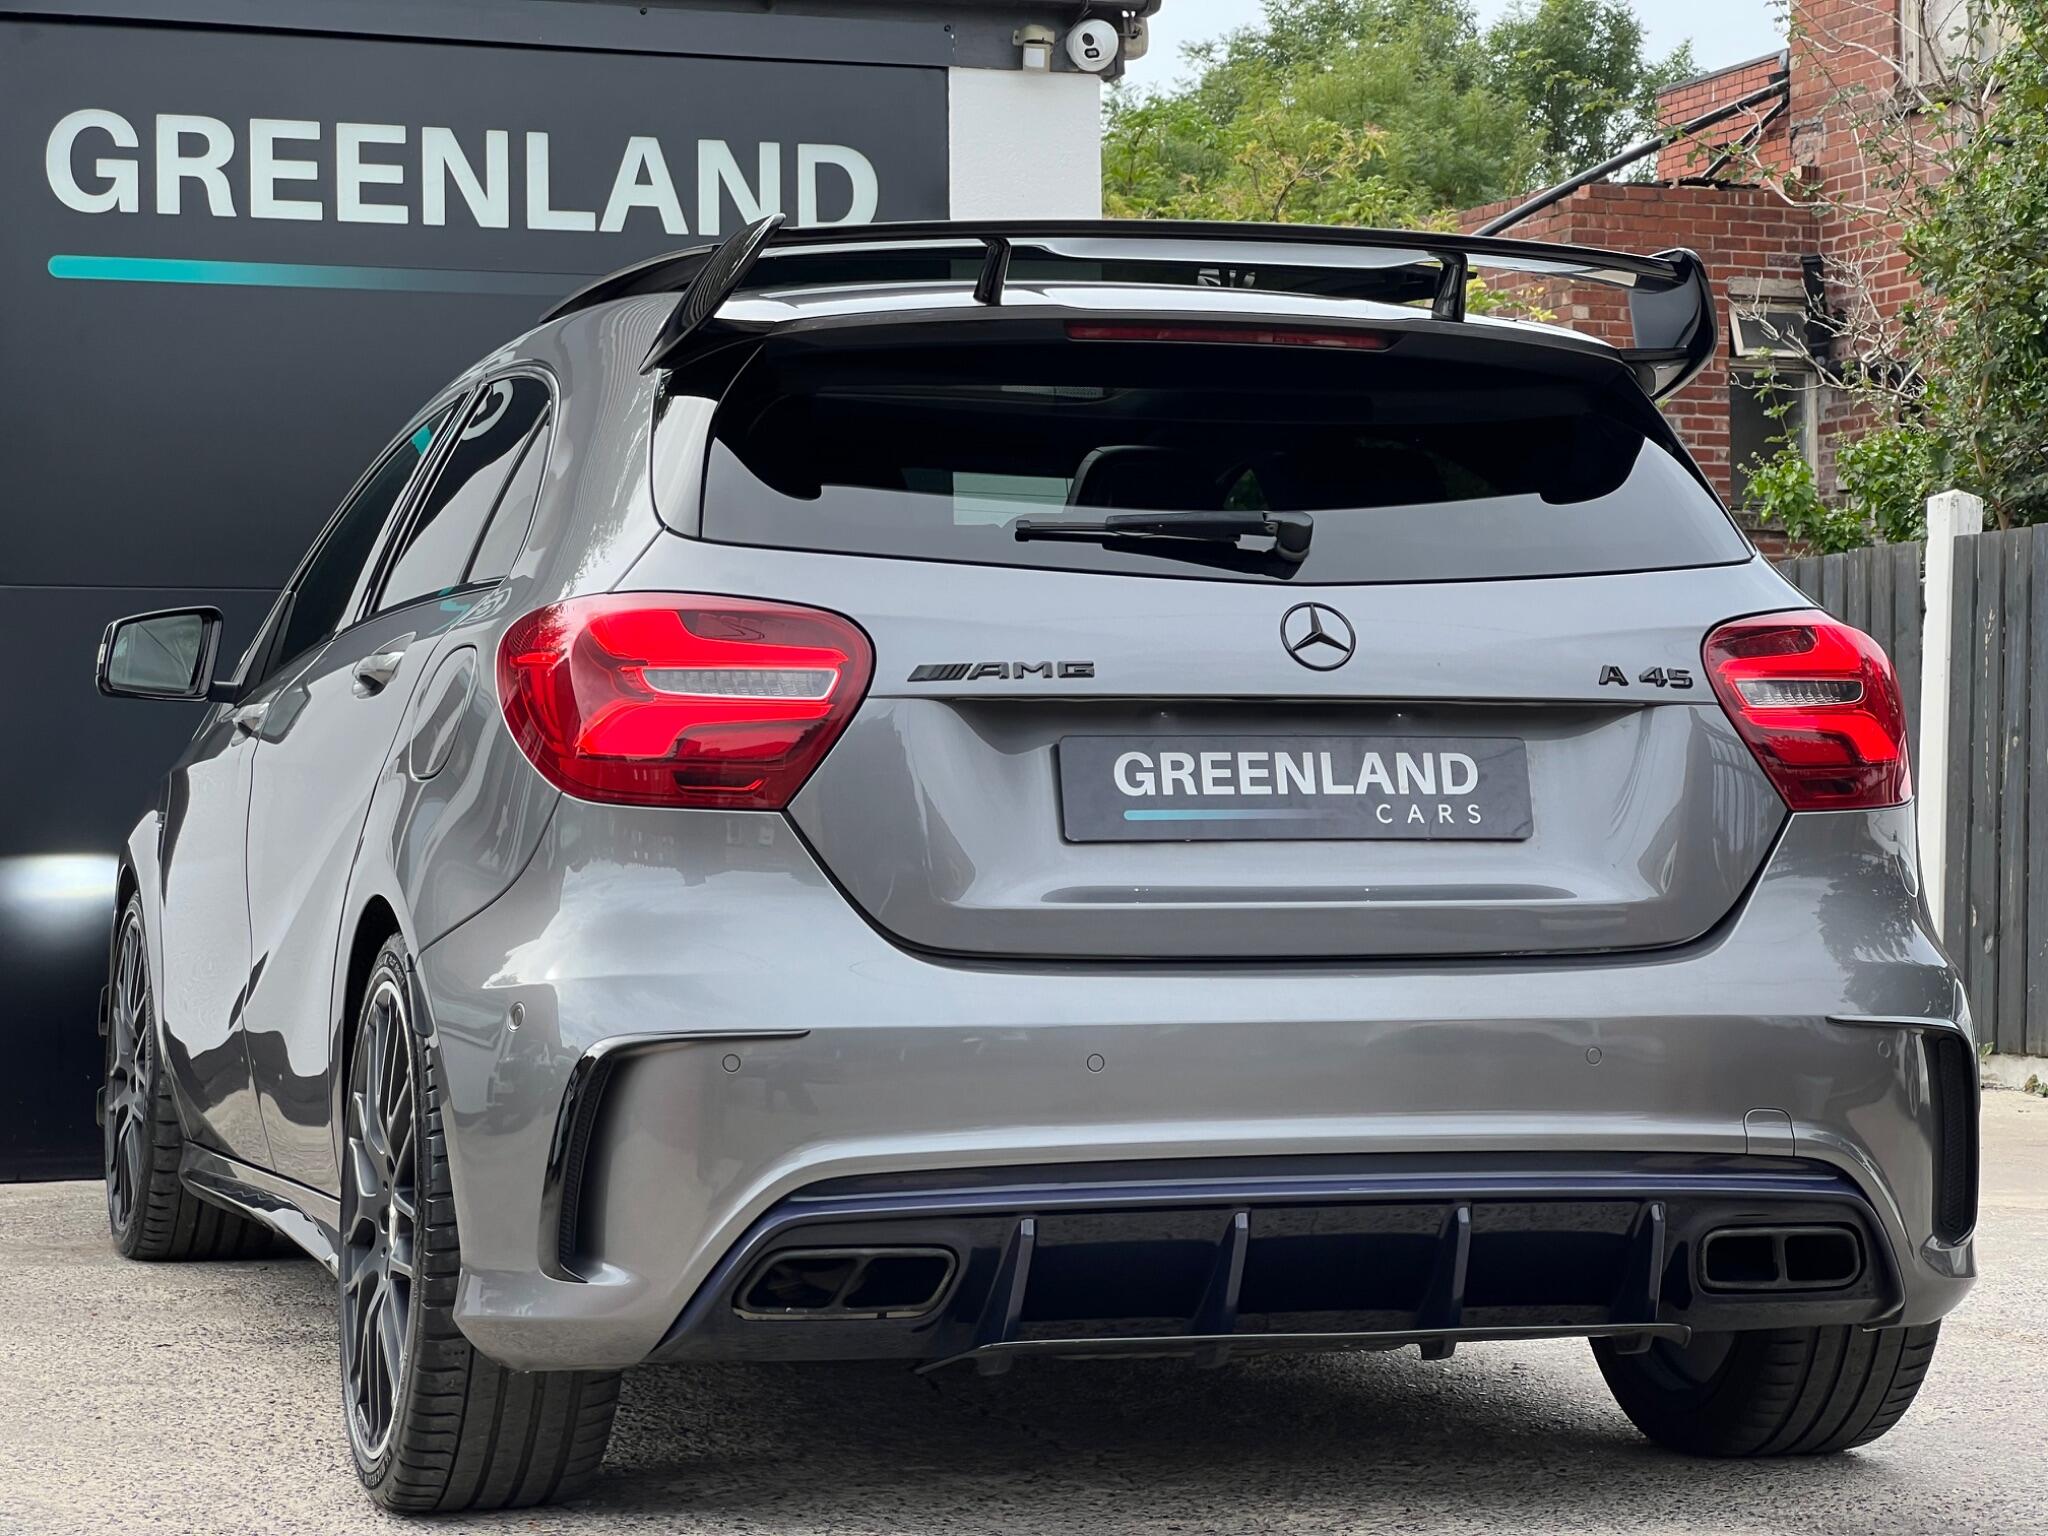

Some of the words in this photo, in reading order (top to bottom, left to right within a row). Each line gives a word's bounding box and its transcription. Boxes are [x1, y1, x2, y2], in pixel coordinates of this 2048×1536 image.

[45, 108, 880, 235] GREENLAND
[967, 661, 1095, 680] AMG
[1599, 664, 1629, 686] A
[1639, 666, 1693, 689] 45
[1113, 751, 1479, 796] GREENLAND
[1376, 803, 1482, 825] CARS
